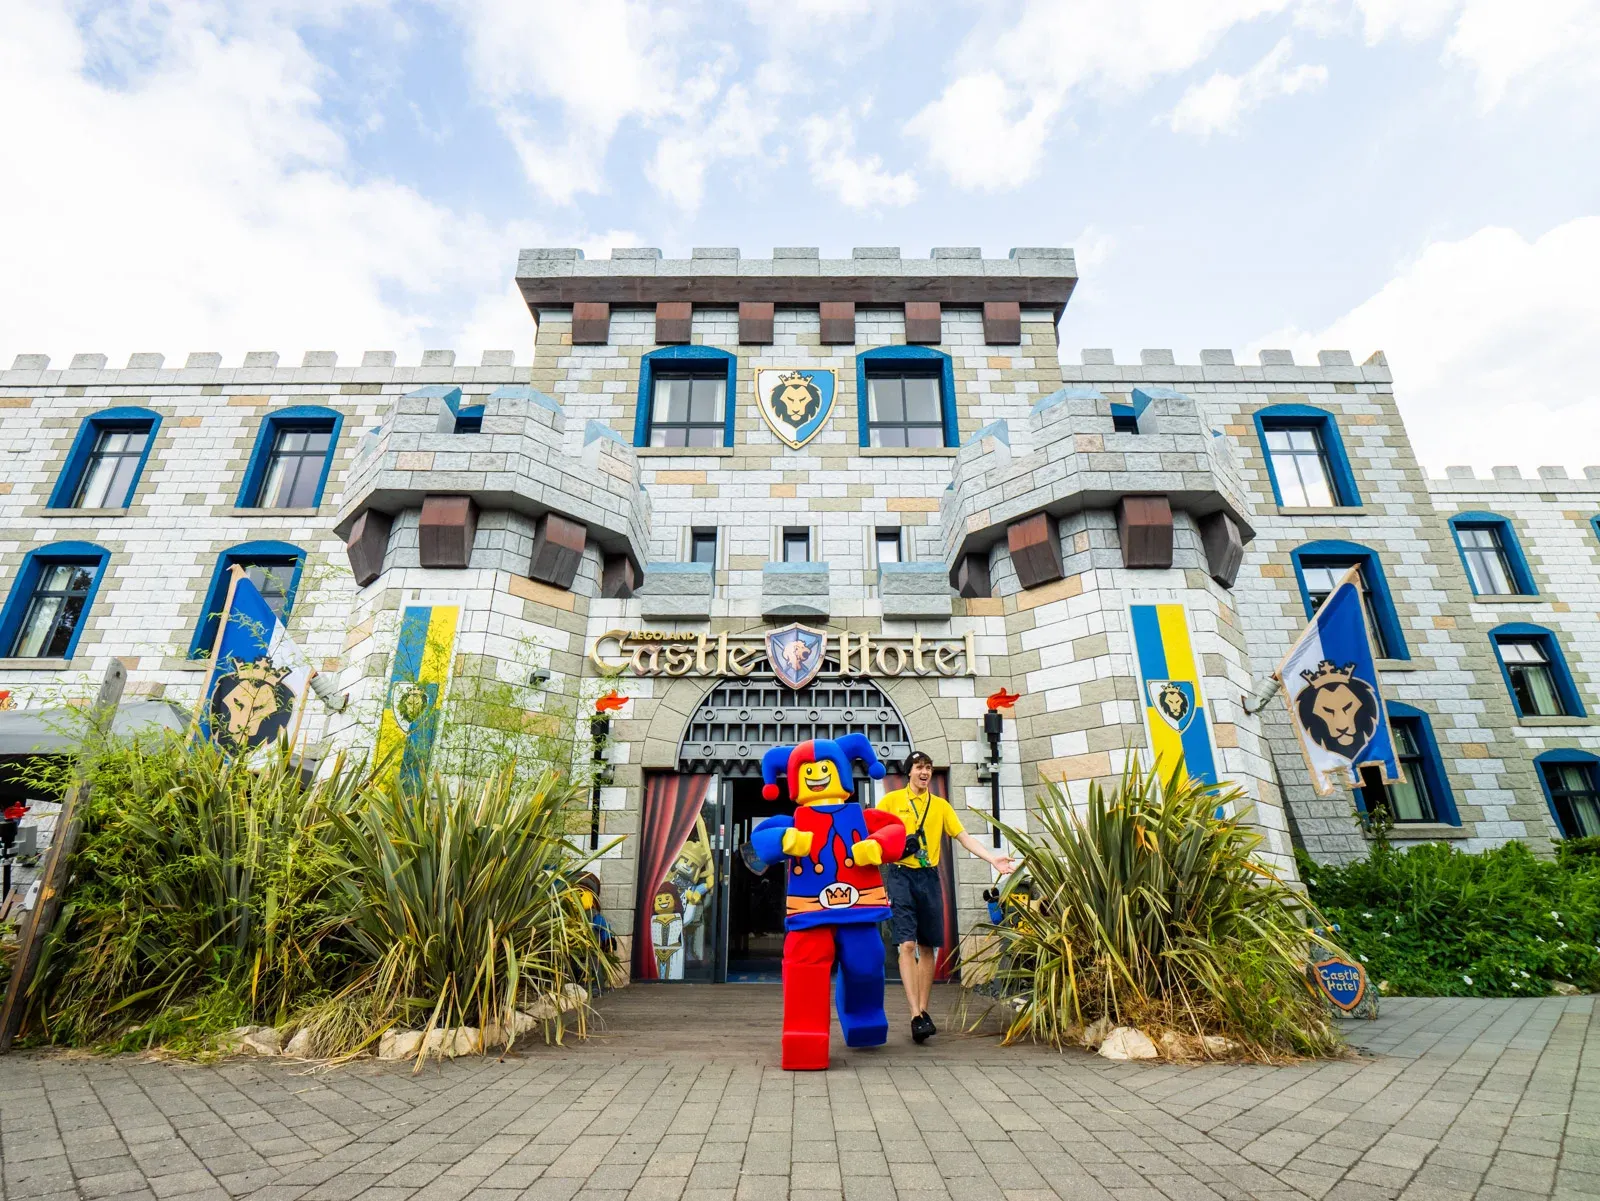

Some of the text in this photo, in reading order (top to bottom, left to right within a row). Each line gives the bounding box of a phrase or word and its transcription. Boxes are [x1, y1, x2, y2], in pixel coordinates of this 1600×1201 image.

[630, 630, 697, 641] LEGOLAND
[589, 629, 977, 676] Castle Hotel
[1320, 969, 1359, 981] Castle
[1327, 980, 1357, 991] Hotel
